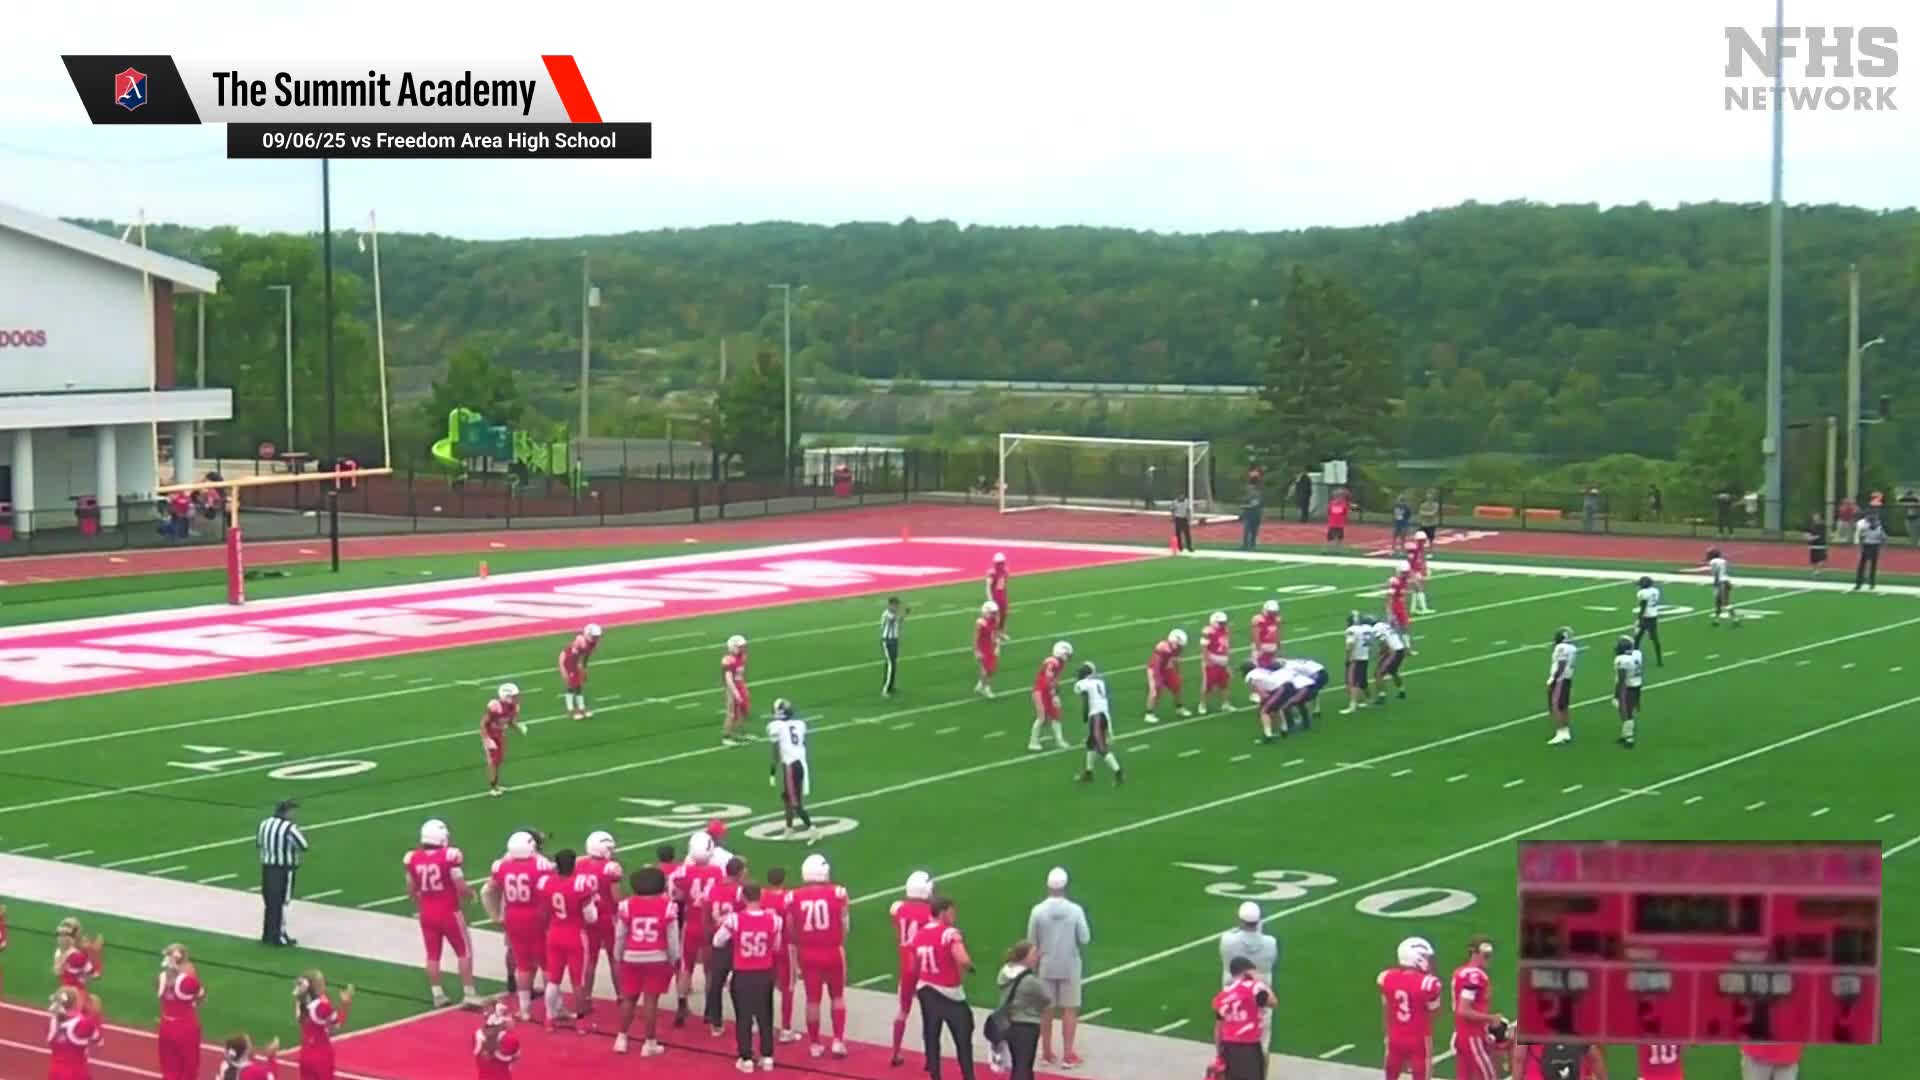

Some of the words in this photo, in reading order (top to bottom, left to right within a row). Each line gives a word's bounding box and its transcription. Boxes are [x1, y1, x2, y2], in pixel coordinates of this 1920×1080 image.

[416, 863, 444, 892] 72
[504, 873, 531, 903] 66
[552, 892, 568, 920] 9
[1204, 869, 1477, 918] 30
[631, 916, 659, 943] 55
[801, 898, 830, 932] 70
[916, 945, 940, 974] 71
[1394, 989, 1412, 1023] 3
